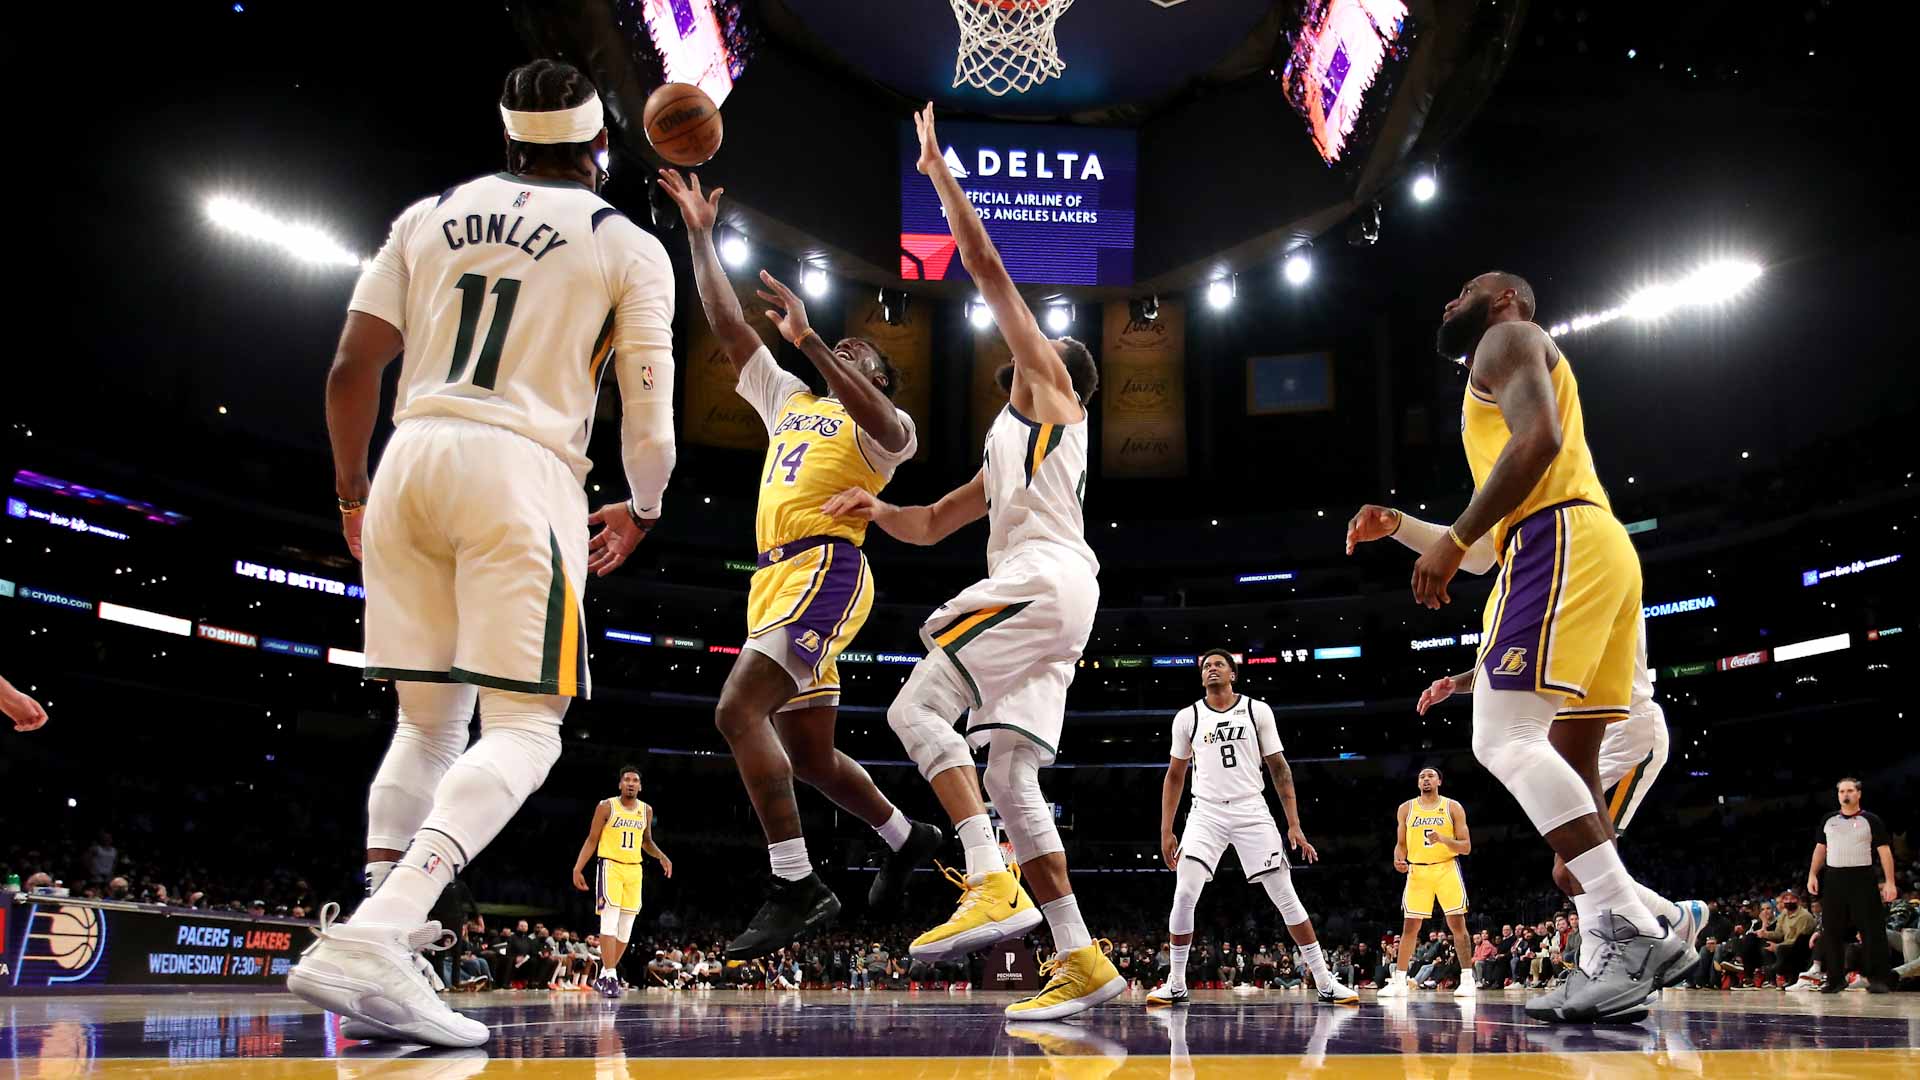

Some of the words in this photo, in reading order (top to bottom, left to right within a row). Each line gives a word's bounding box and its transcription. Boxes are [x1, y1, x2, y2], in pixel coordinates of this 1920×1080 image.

[978, 149, 1104, 181] DELTA
[965, 191, 1011, 205] FFICIAL
[1014, 193, 1063, 207] AIRLINE
[1065, 194, 1083, 208] OF
[975, 207, 991, 220] OS
[993, 207, 1049, 222] ANGELES
[1052, 210, 1098, 224] LAKERS
[442, 213, 568, 262] CONLEY
[445, 273, 522, 391] 11
[774, 412, 844, 437] LAKERS
[766, 442, 810, 484] 14
[235, 560, 268, 580] LIFE
[269, 568, 287, 584] IS
[287, 572, 346, 595] BETTER
[32, 590, 93, 611] crypto.com
[198, 625, 257, 648] TOSHIBA
[1879, 627, 1903, 637] TOYOTA
[294, 645, 319, 656] ULTRA
[674, 639, 694, 647] TOYOTA
[1411, 637, 1454, 650] Spectrum
[840, 653, 873, 662] DELTA
[884, 655, 922, 663] crypto.com
[1204, 721, 1249, 744] JAZZ
[1220, 744, 1237, 768] 8
[611, 816, 643, 829] LAKERS
[1411, 816, 1444, 828] LAKERS
[621, 831, 634, 849] 11
[177, 925, 231, 947] PACERS
[245, 930, 292, 950] LAKERS
[149, 953, 225, 974] WEDNESDAY
[231, 956, 255, 975] 7:30
